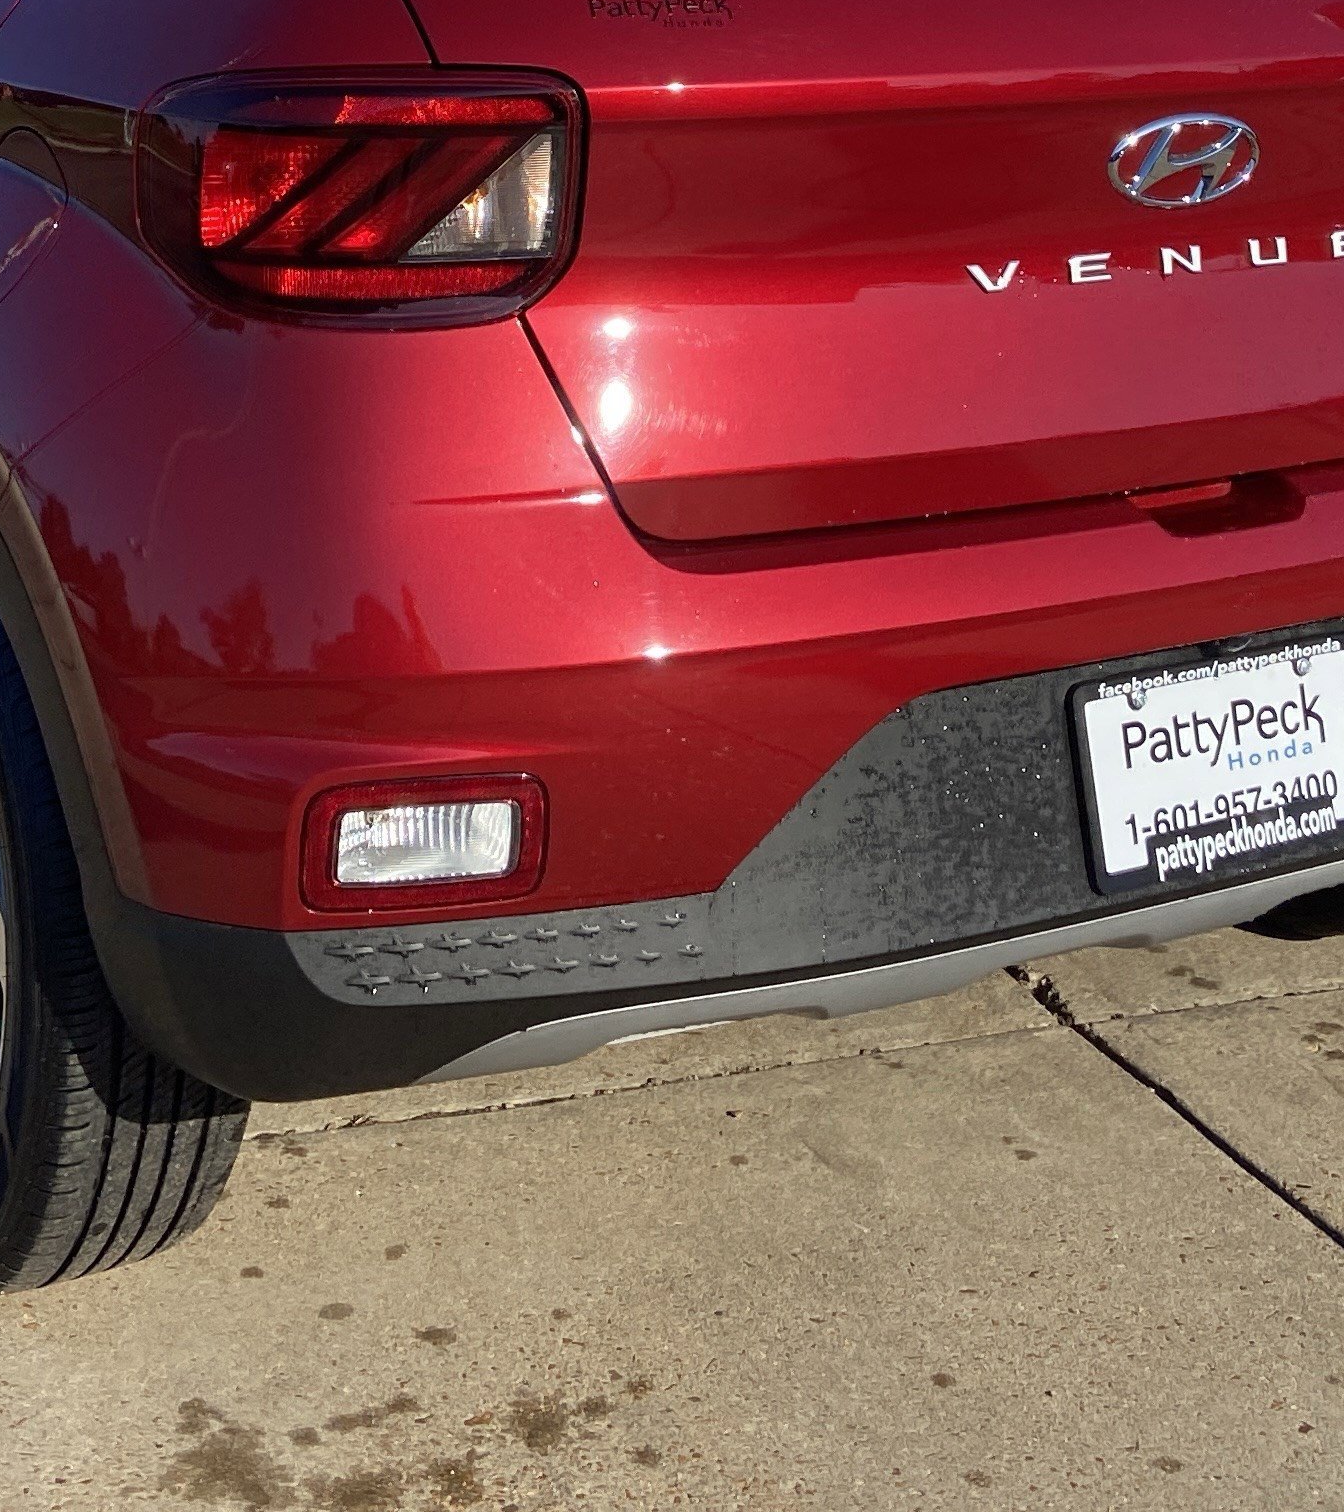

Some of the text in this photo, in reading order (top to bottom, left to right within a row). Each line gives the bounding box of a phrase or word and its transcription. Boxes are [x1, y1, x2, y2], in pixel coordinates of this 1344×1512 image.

[1097, 637, 1342, 700] facebook.com/pattypeckhonda
[1121, 683, 1327, 769] PattyPeck
[1227, 738, 1314, 771] Honda
[1124, 769, 1338, 846] 1-601-957-3400
[1155, 803, 1337, 882] pattypeckhonda.com
